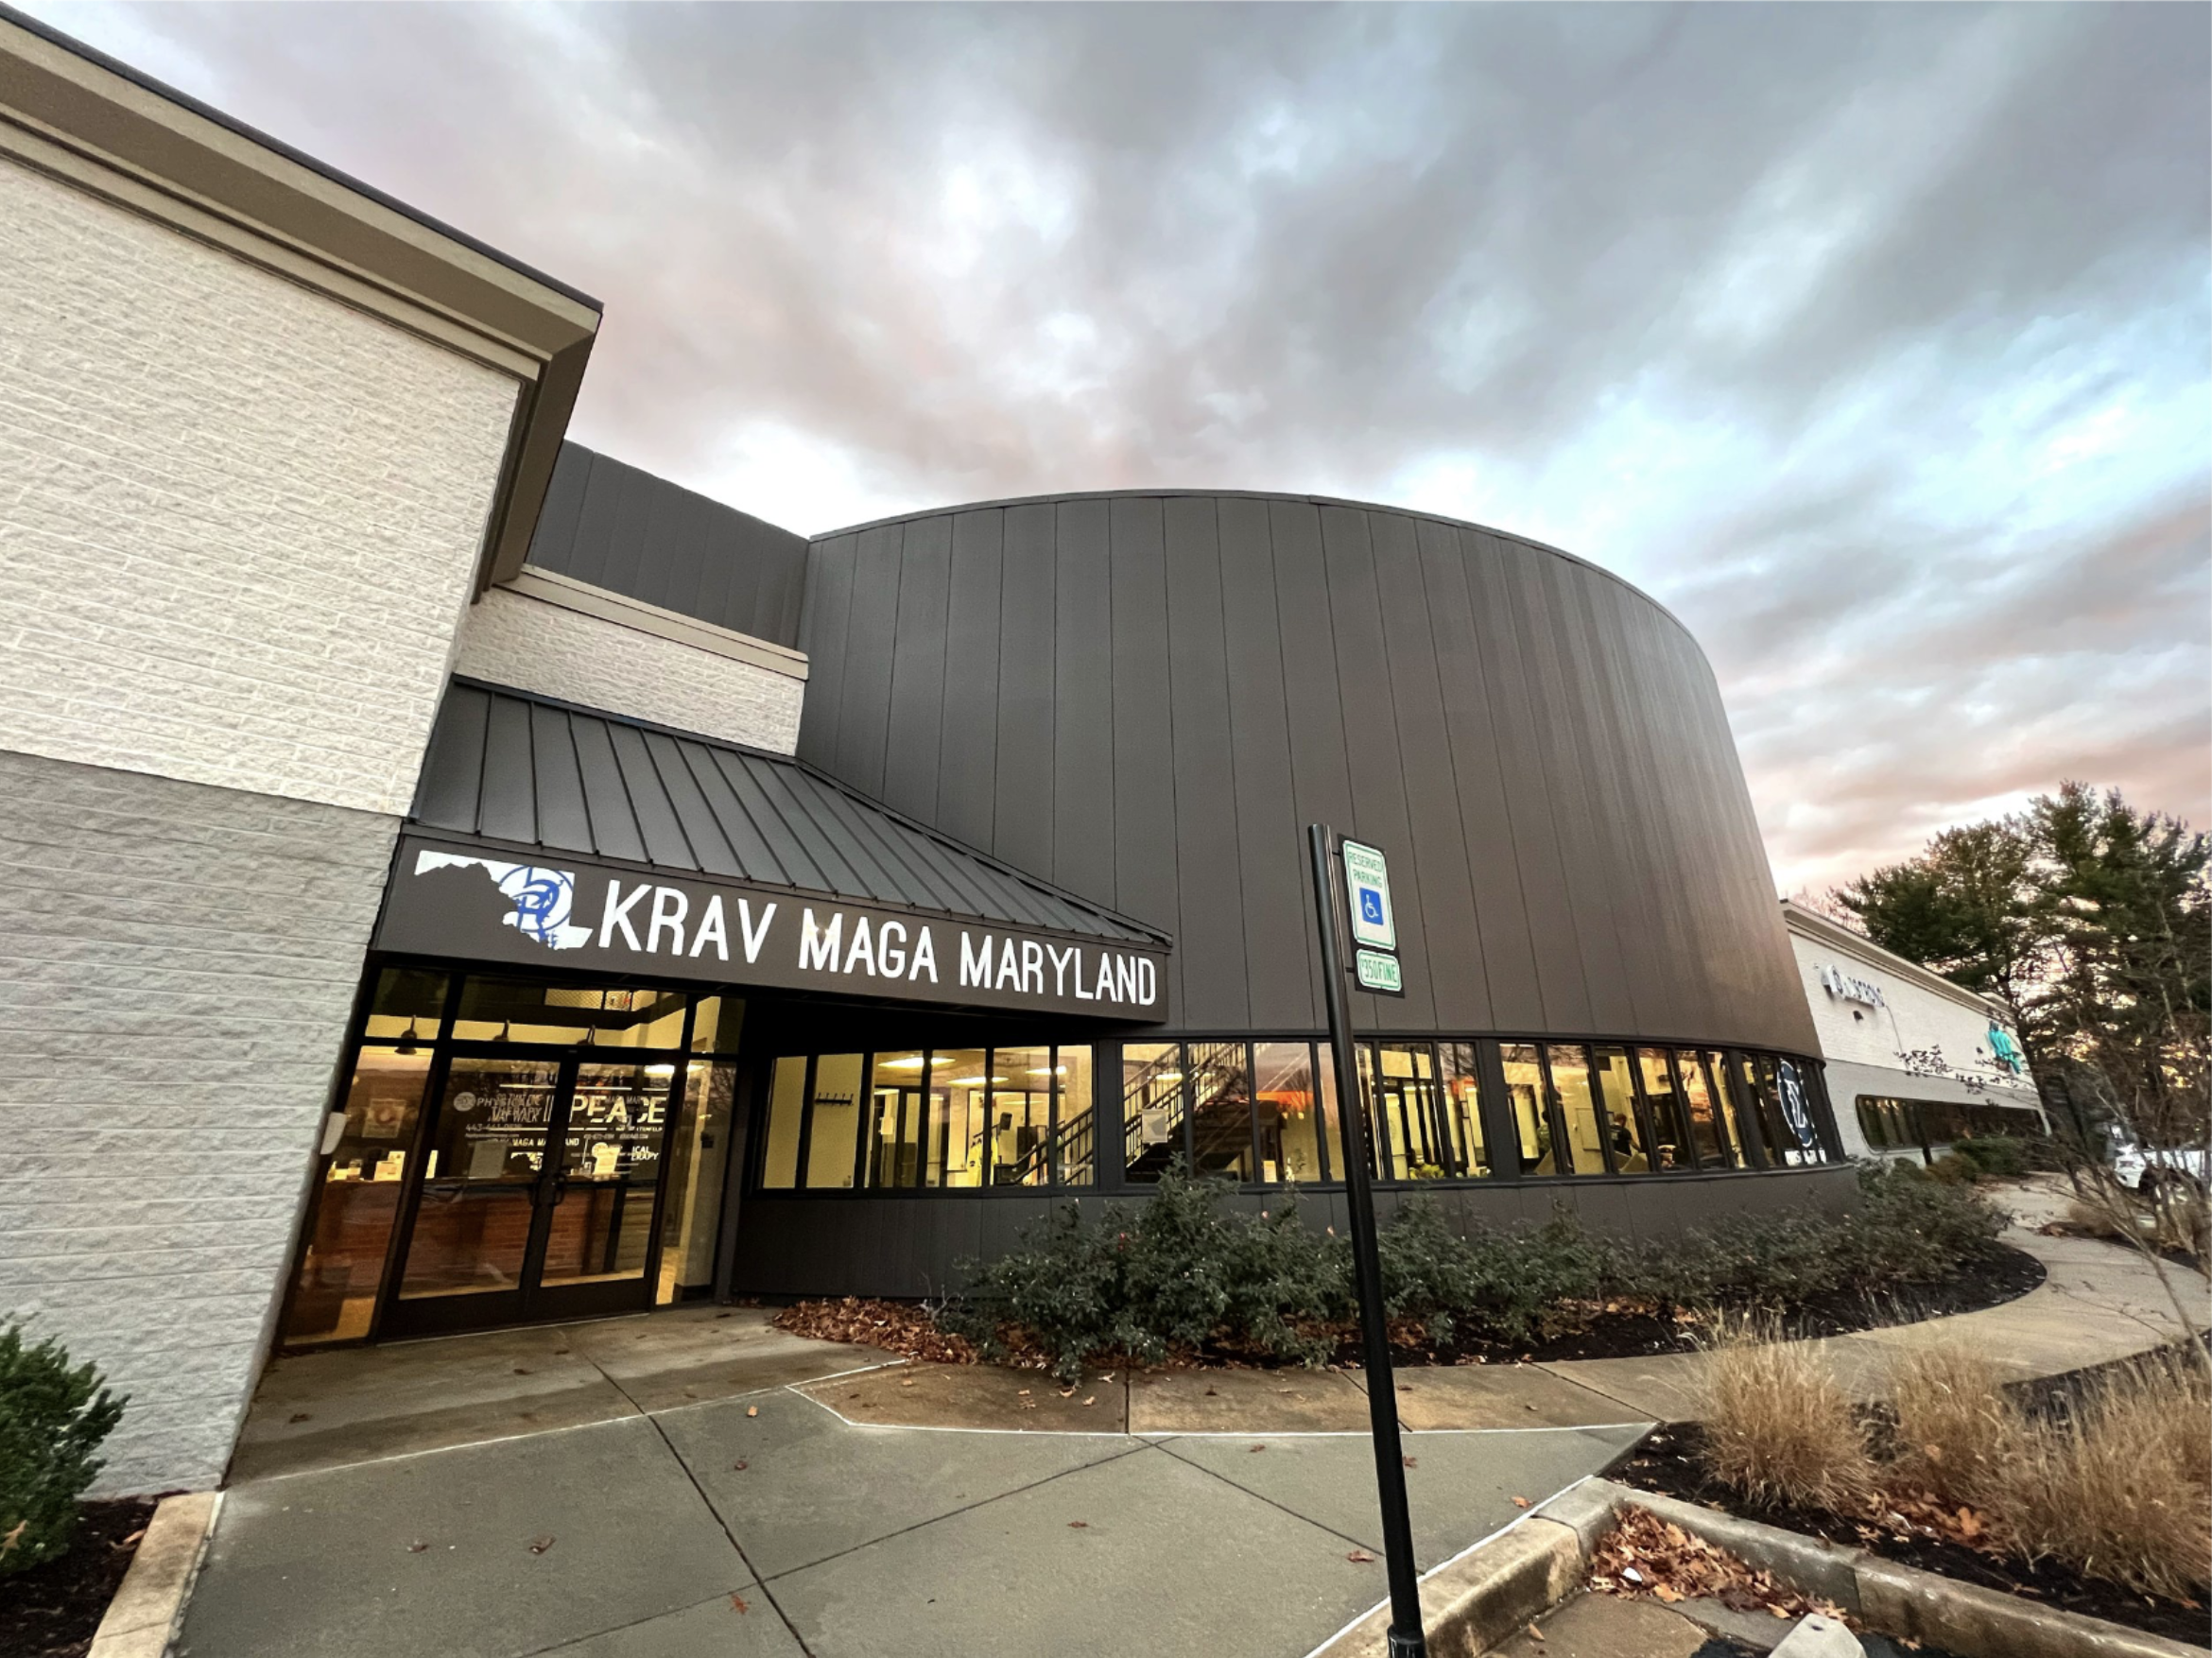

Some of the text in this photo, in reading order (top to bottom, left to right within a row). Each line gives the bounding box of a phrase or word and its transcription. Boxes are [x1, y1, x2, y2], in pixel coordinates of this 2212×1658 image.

[1348, 852, 1383, 872] RESERVED
[1353, 869, 1383, 889] PARKING
[598, 879, 1156, 1006] KRAV MAGA MARYLAND
[1377, 962, 1398, 983] FINE
[511, 1137, 534, 1147] MAGA
